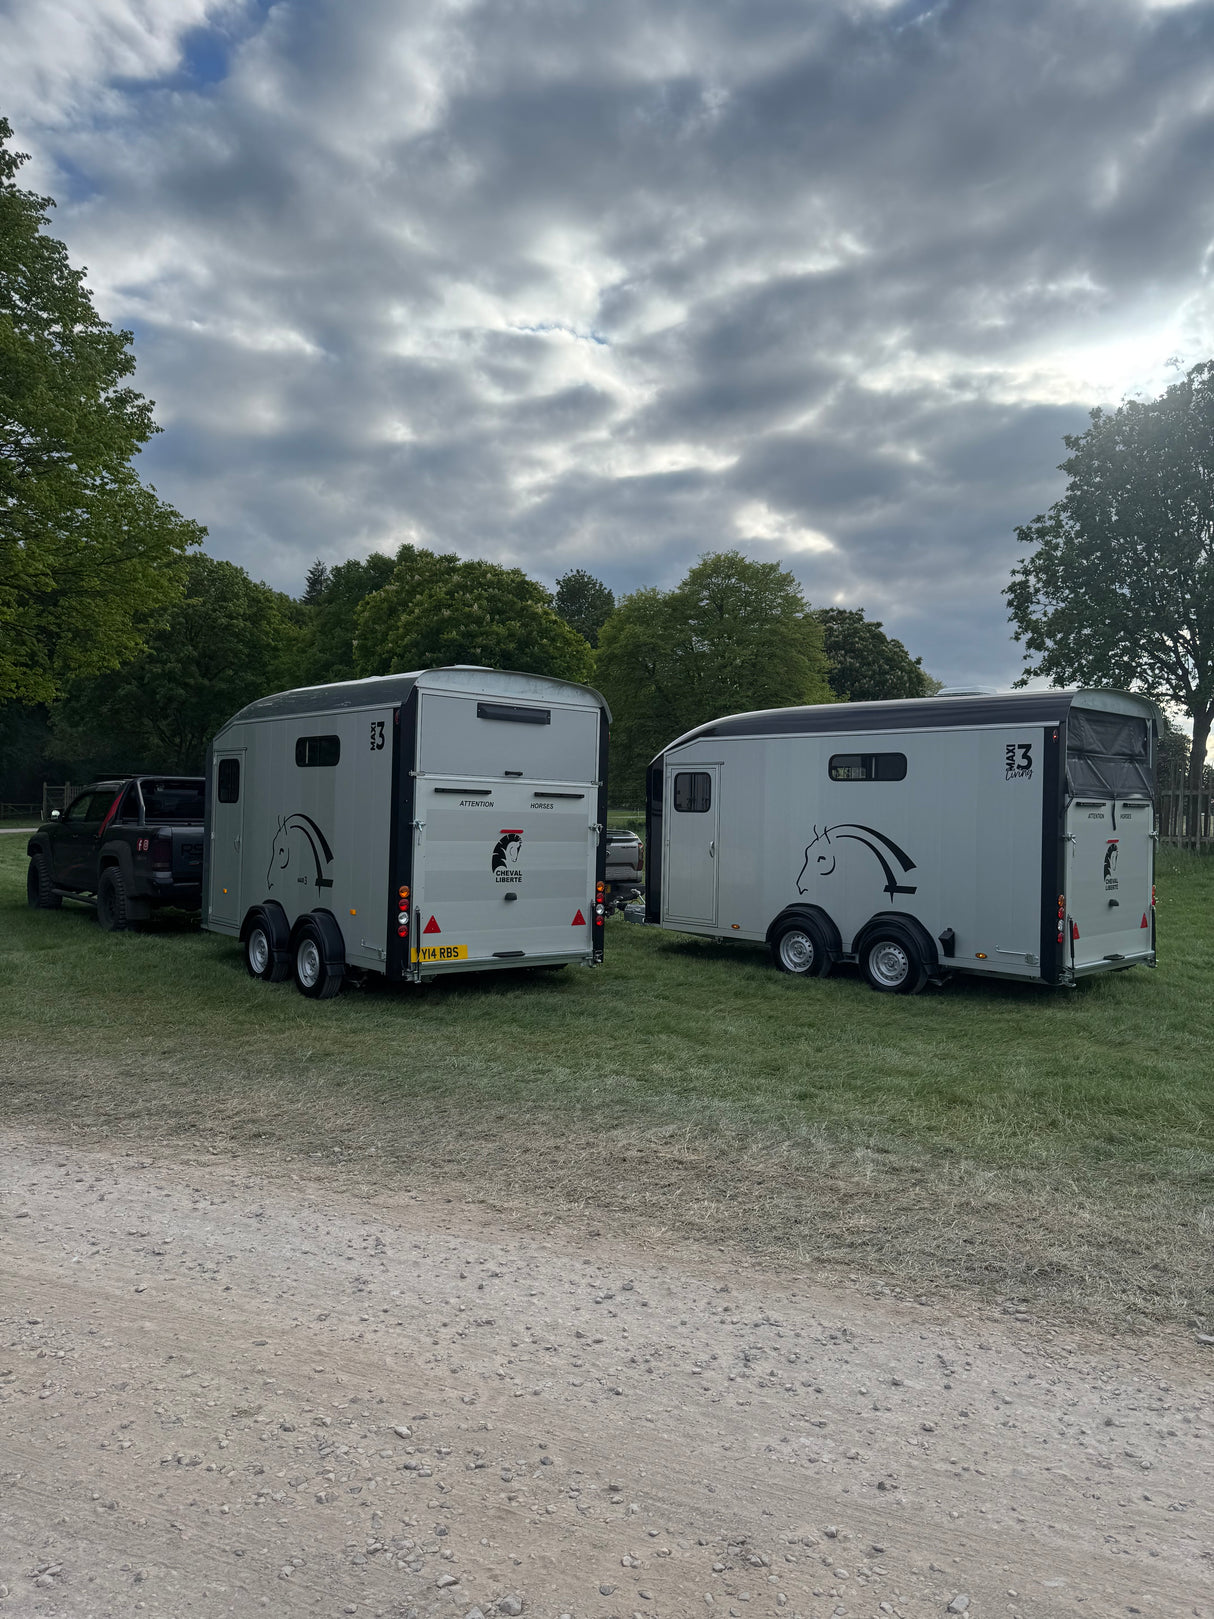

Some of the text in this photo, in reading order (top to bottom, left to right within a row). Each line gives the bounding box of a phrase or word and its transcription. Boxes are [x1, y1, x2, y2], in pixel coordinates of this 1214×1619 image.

[376, 721, 385, 750] 3
[1006, 744, 1016, 771] MAXI
[1016, 744, 1032, 770] 3
[1005, 768, 1033, 781] Living
[459, 800, 494, 808] ATTENTION
[421, 946, 459, 960] Y14 RBS
